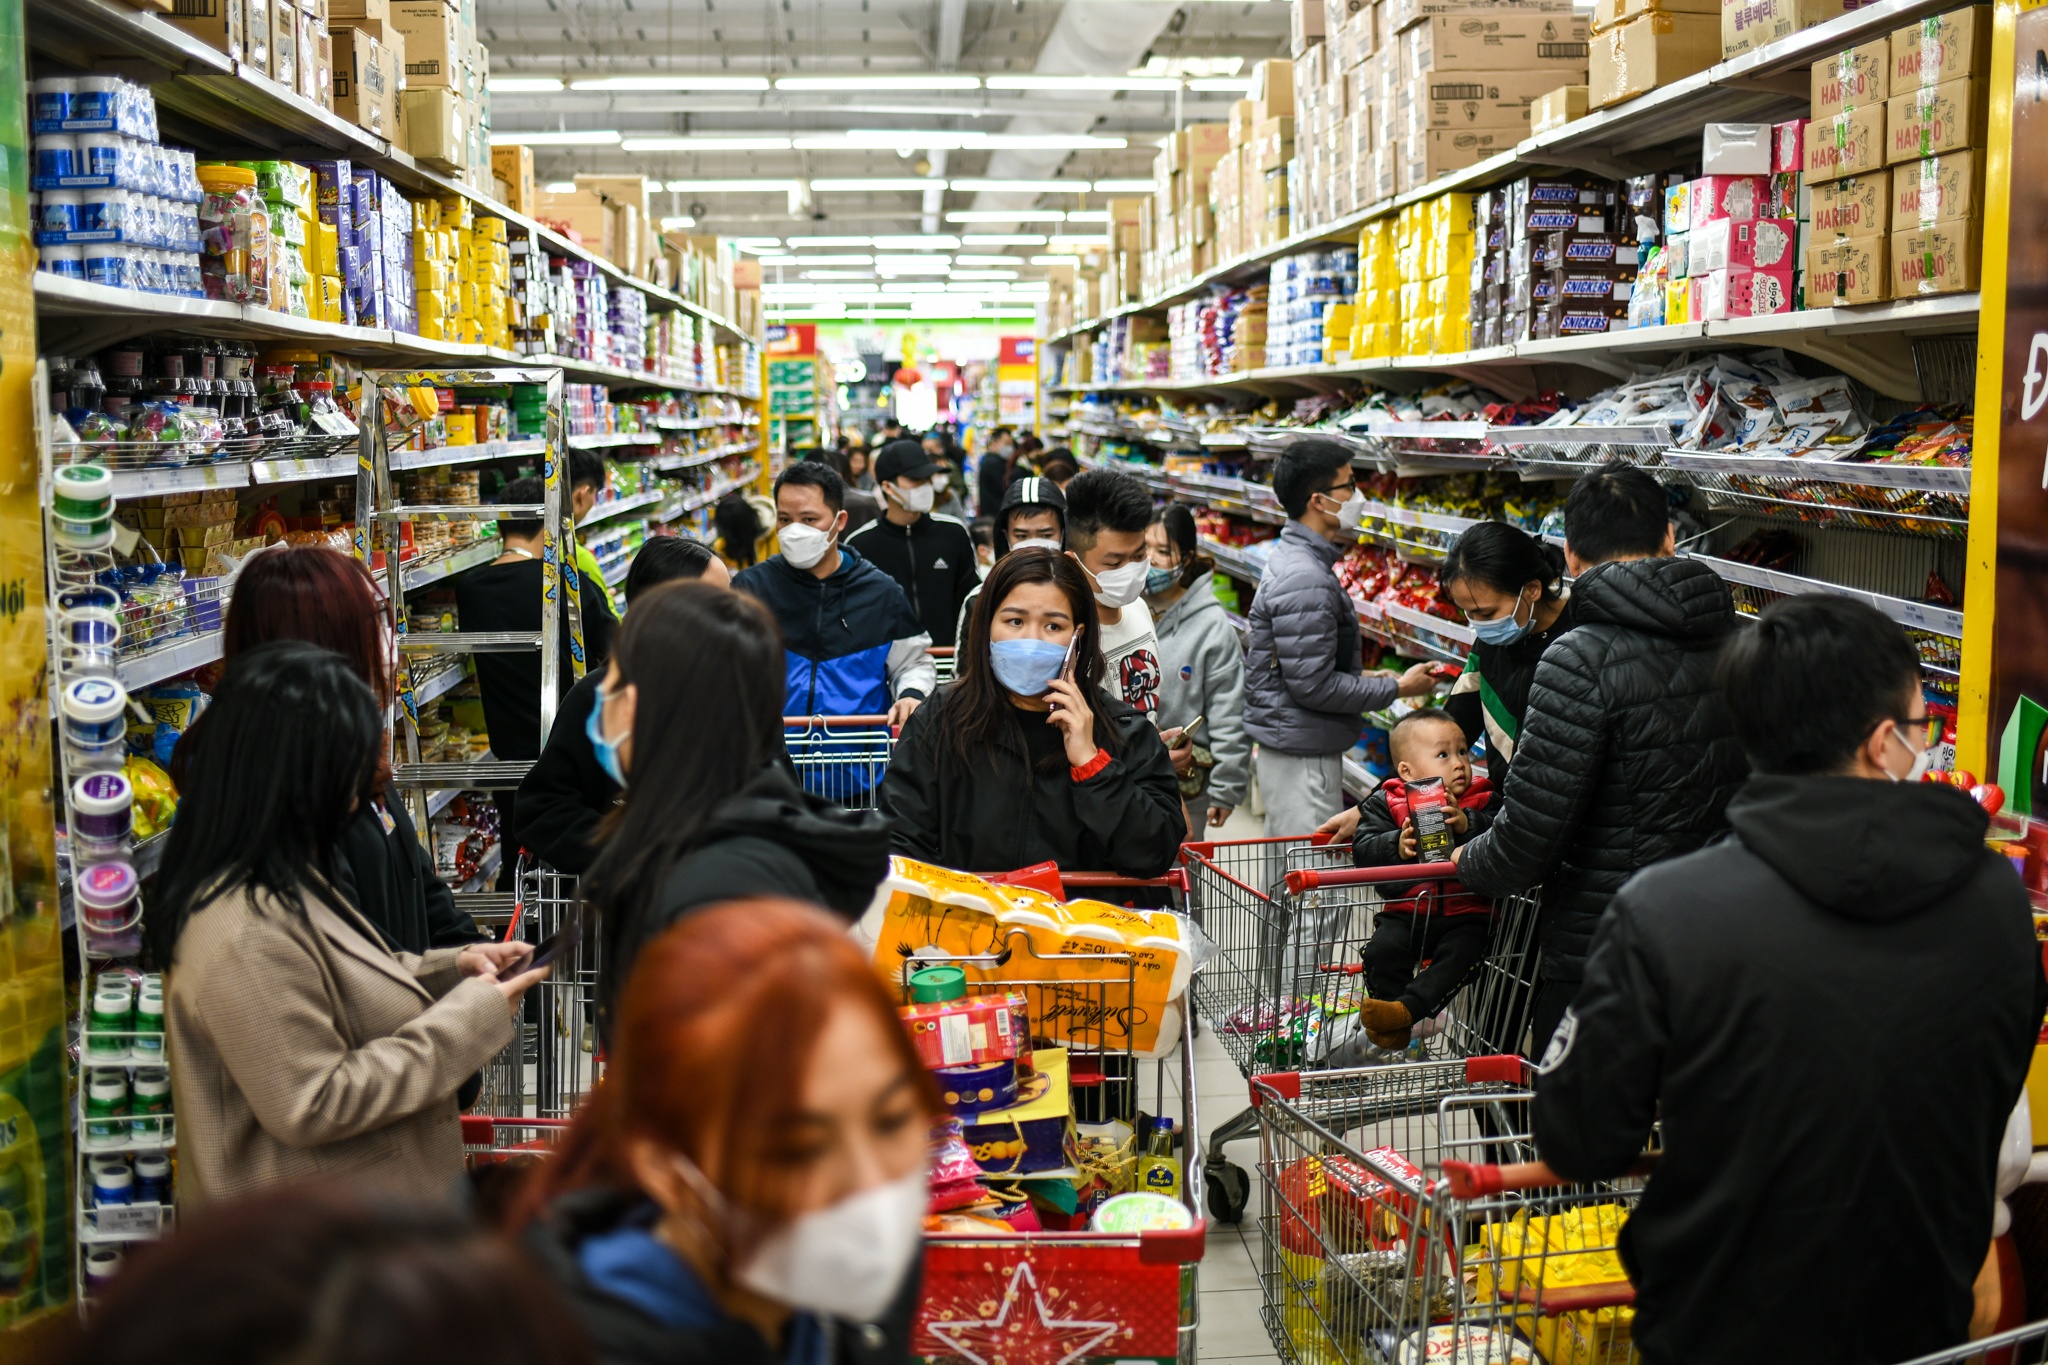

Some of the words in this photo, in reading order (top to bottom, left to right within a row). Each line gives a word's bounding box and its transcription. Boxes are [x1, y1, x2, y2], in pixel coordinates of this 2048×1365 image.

[1735, 0, 1772, 31] 블루베리
[1533, 188, 1577, 200] SNICKERS
[1530, 214, 1576, 226] SNICKERS
[1567, 244, 1613, 256] SNICKERS
[1564, 281, 1611, 293] SNICKERS
[1770, 282, 1778, 302] play
[1758, 277, 1767, 314] CUPCAKE
[1562, 316, 1607, 329] SNICKERS
[1071, 941, 1079, 950] 4
[1094, 944, 1106, 954] 10
[1138, 951, 1155, 959] CAO
[1110, 958, 1128, 966] SINH
[1039, 1004, 1148, 1037] Silkwell
